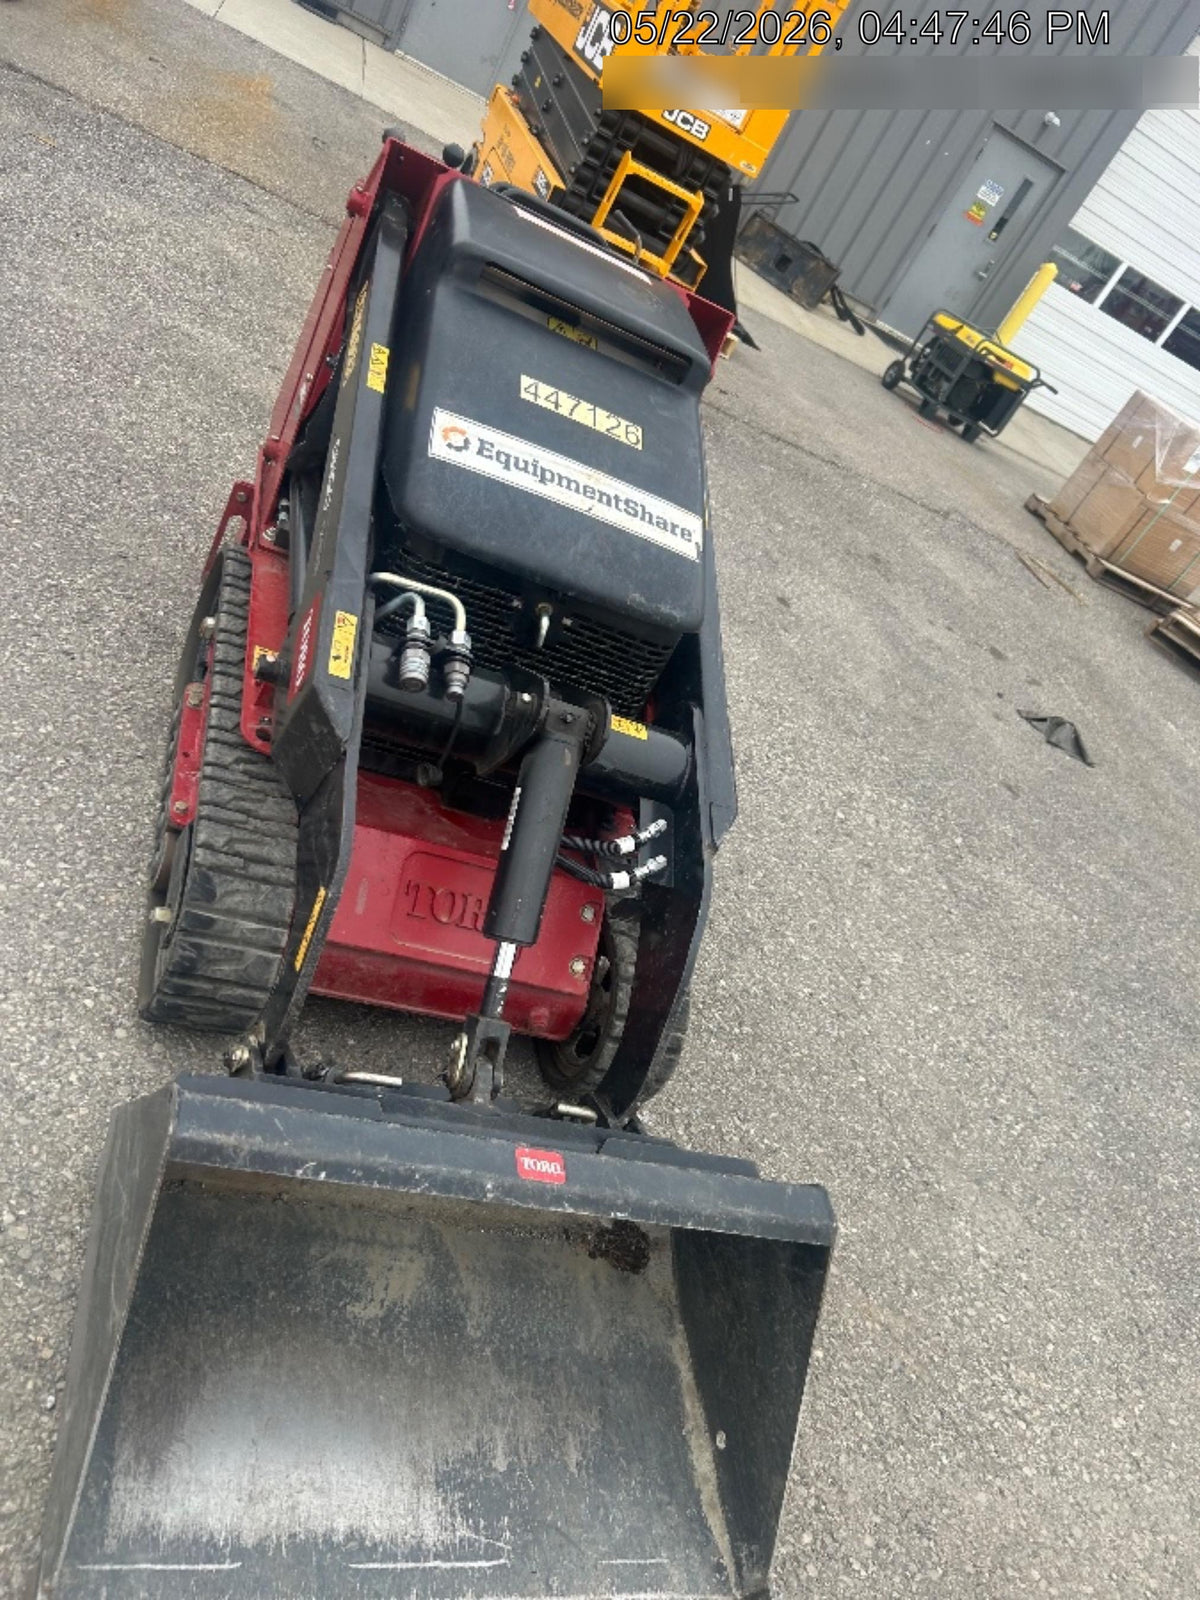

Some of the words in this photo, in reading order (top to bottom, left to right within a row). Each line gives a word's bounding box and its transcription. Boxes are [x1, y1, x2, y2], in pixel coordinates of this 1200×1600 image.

[662, 109, 709, 140] JCB
[523, 380, 641, 447] 447126
[476, 436, 693, 542] EquipmentShare
[404, 879, 484, 932] TOR
[520, 1156, 563, 1175] TORO
